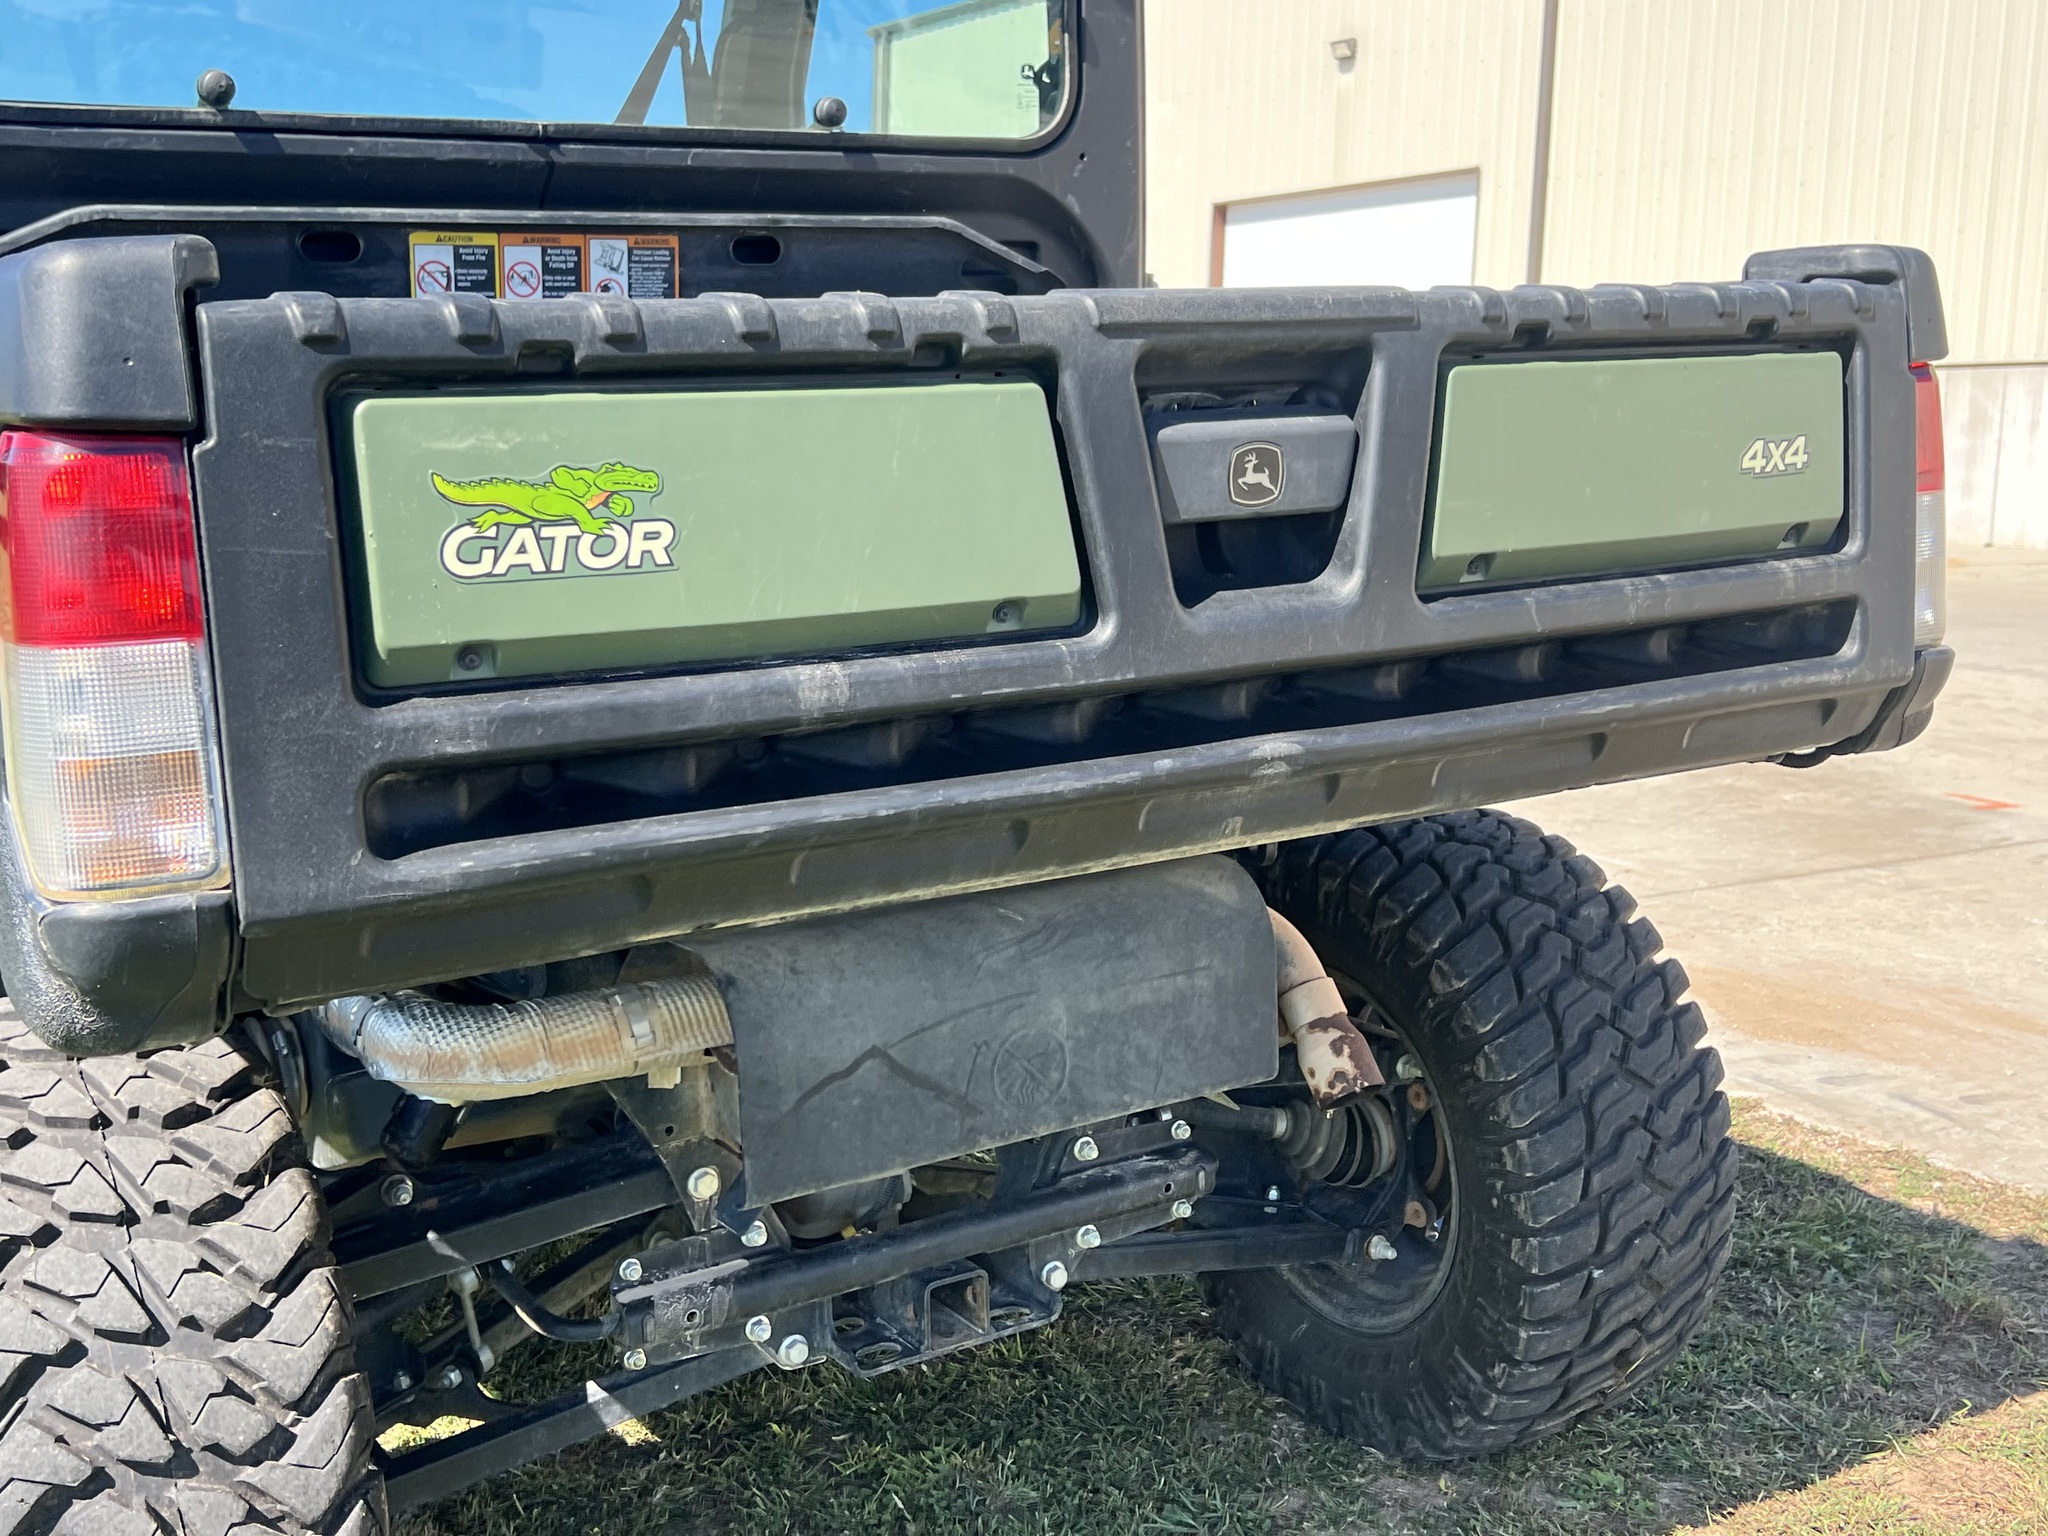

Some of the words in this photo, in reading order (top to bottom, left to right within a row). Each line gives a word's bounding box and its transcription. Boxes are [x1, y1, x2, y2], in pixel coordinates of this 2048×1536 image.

[443, 235, 474, 243] CAUTION
[530, 236, 561, 244] WARNING
[640, 238, 670, 246] WARNING
[561, 248, 576, 256] Injury
[441, 519, 674, 578] GATOR
